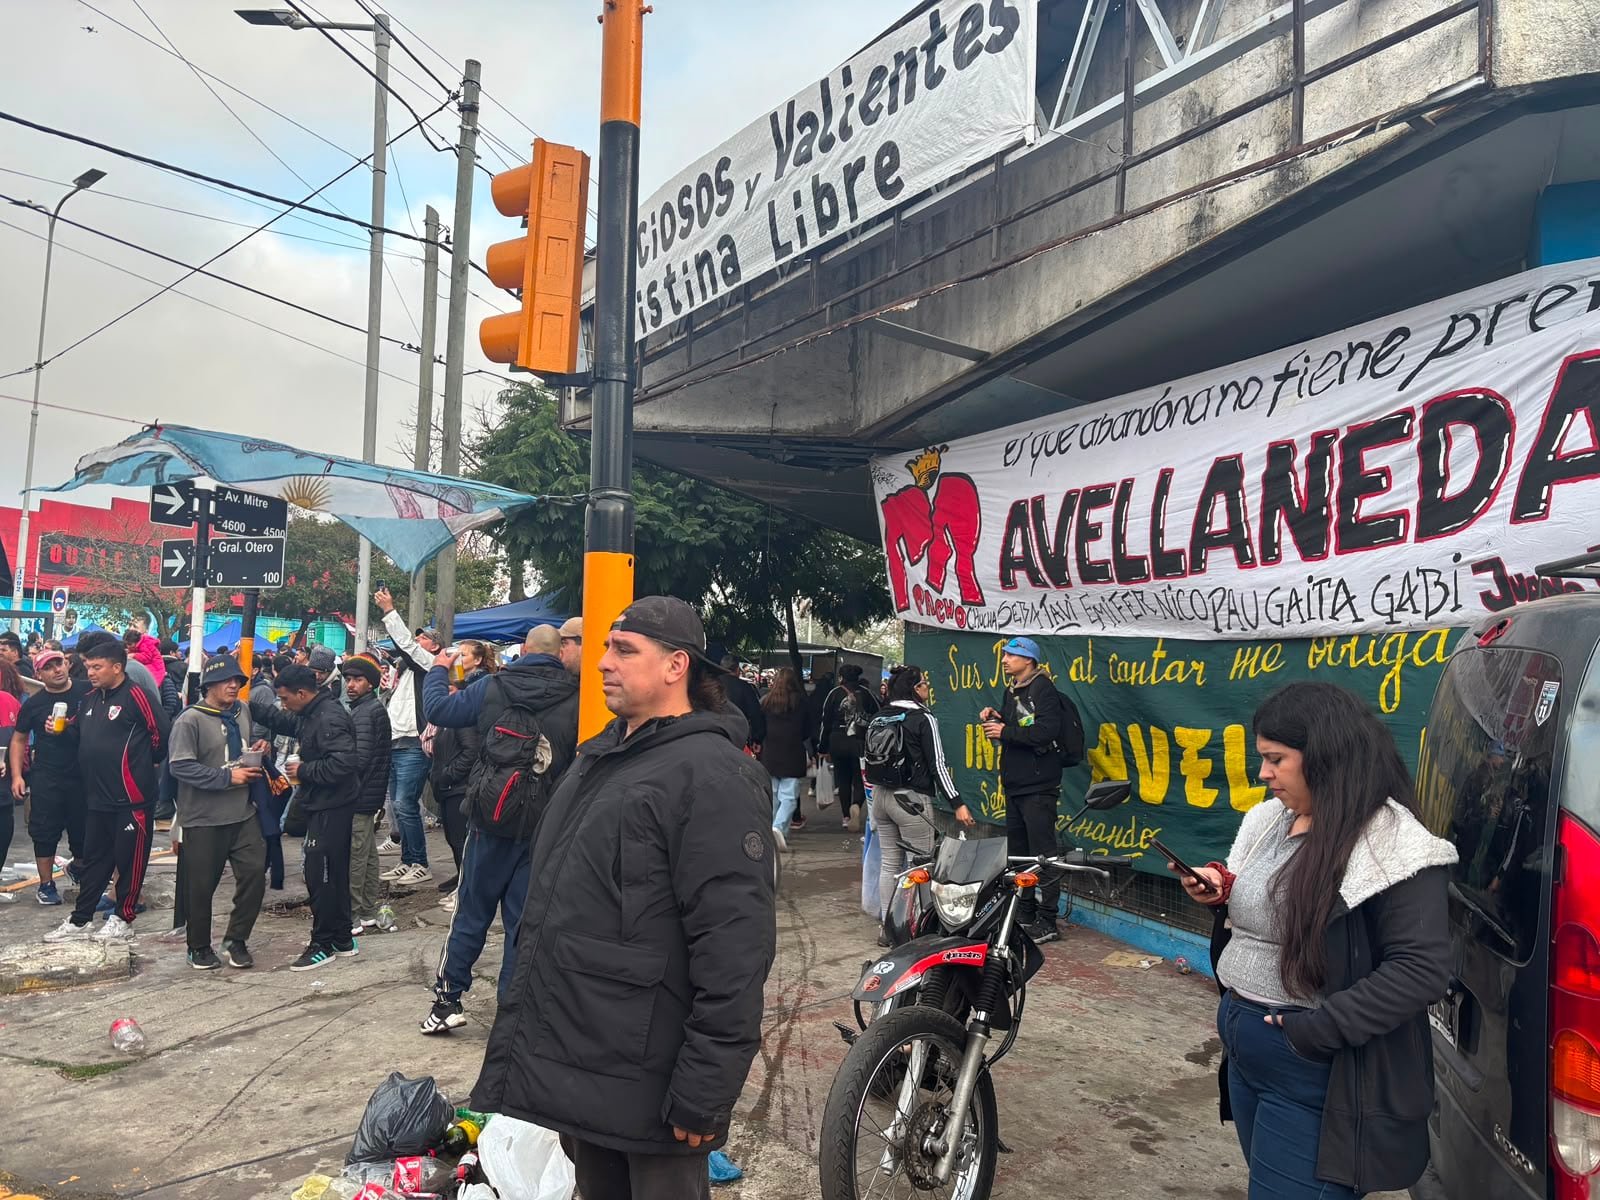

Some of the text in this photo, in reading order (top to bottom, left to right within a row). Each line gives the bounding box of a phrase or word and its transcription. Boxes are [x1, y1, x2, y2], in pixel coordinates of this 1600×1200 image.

[637, 1, 1020, 269] ciosos y Valientes
[636, 140, 905, 334] istina Libre
[1030, 423, 1080, 477] que
[1215, 376, 1263, 418] no
[1266, 327, 1411, 417] tiene
[999, 349, 1600, 590] AVELLANEDA
[224, 490, 269, 509] Av. Mitre
[218, 541, 274, 553] Gral. Otero
[221, 520, 246, 533] 4600
[263, 526, 286, 537] 4500
[216, 572, 223, 583] 0
[263, 572, 280, 583] 100
[1208, 587, 1259, 633] PAU
[949, 644, 984, 692] Sus
[1069, 638, 1098, 685] al
[1109, 638, 1207, 687] cantar
[1229, 642, 1286, 681] me
[1087, 723, 1268, 812] AVEL
[980, 776, 1006, 817] Seb
